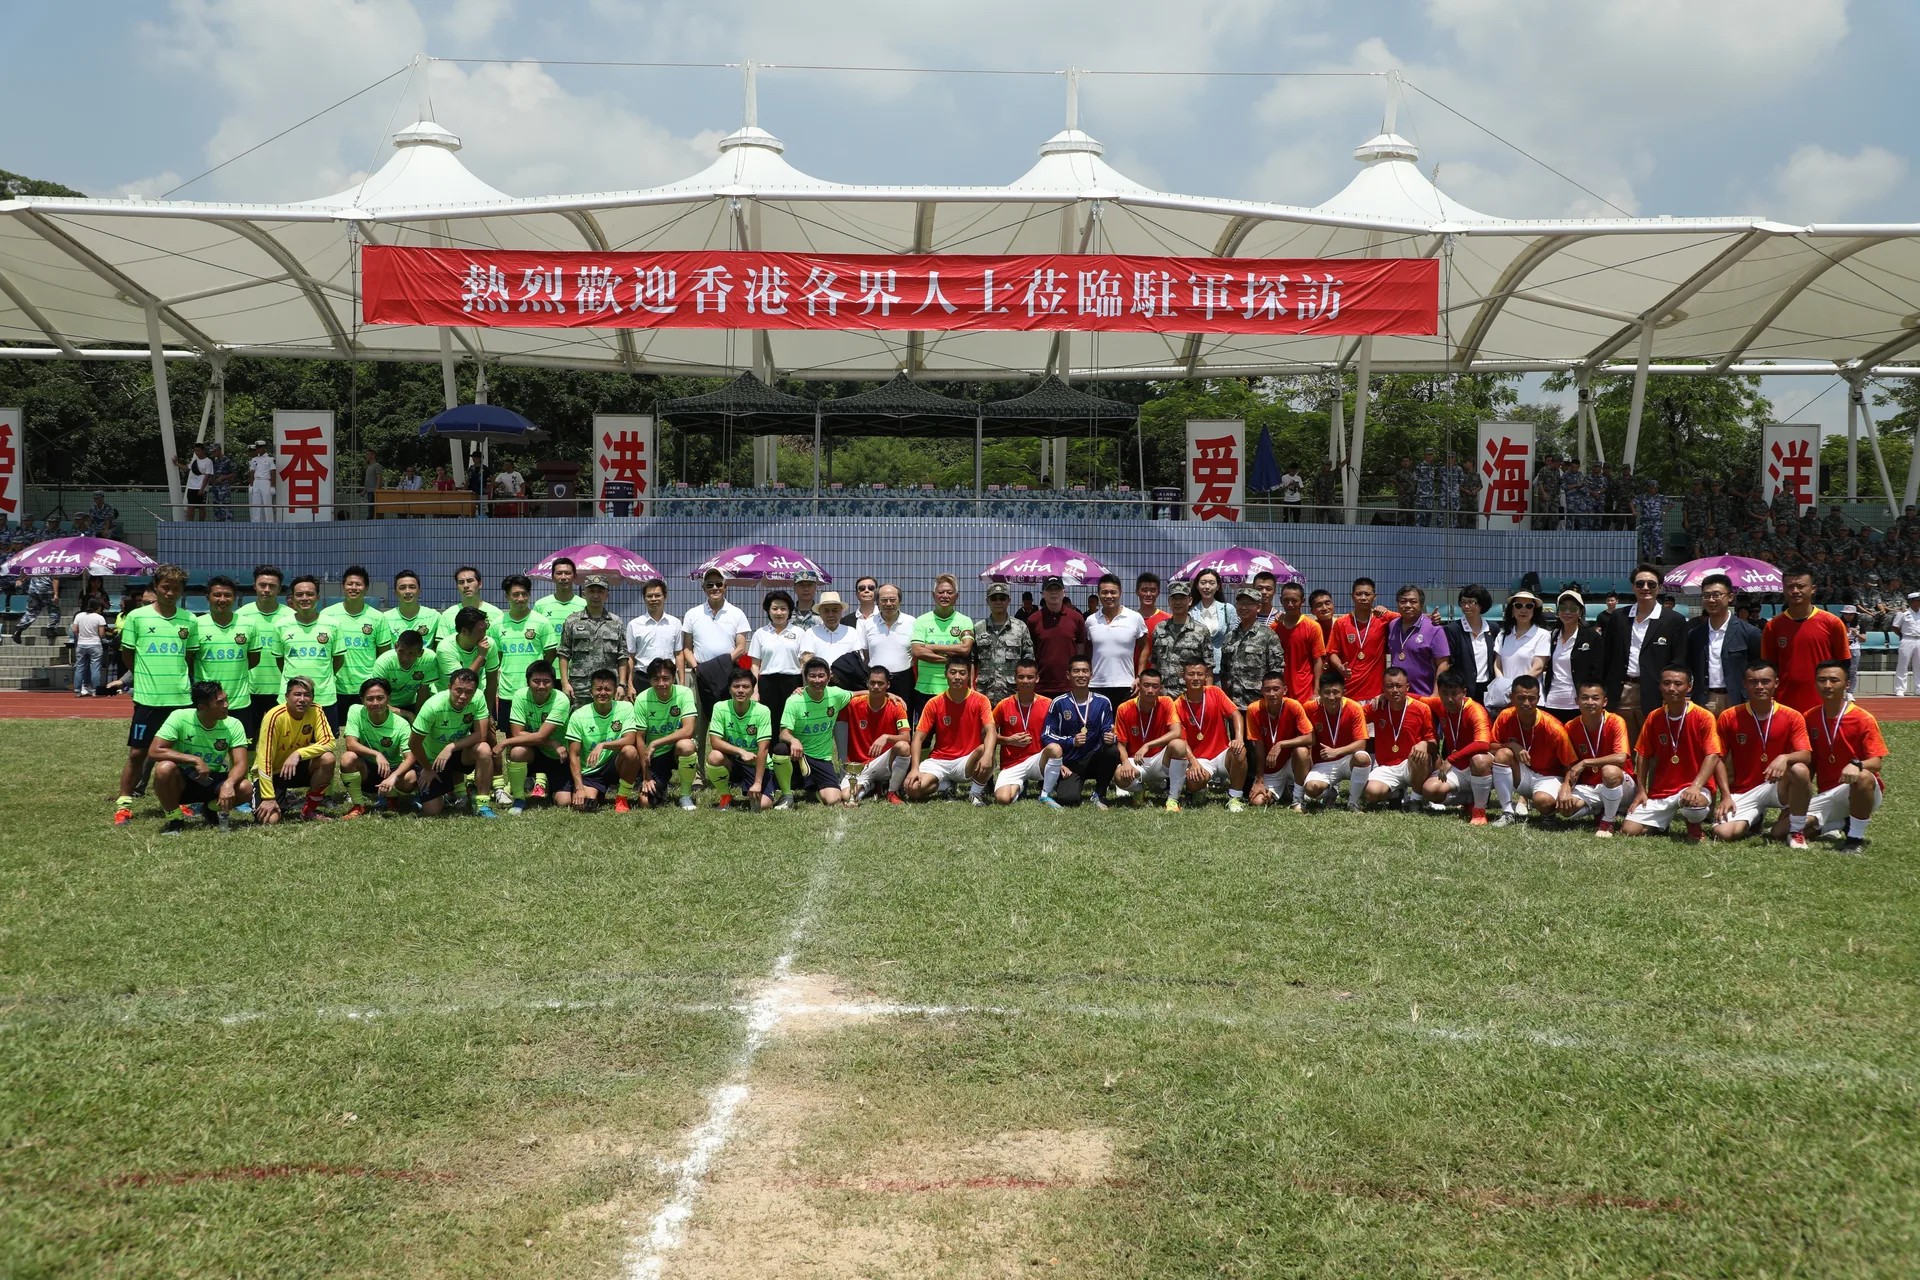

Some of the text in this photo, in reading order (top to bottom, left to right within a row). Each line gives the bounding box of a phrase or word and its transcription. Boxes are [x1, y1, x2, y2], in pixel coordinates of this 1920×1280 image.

[459, 264, 1346, 322] 熱烈歡迎香港各界人士莅臨駐軍探訪
[279, 426, 329, 514] 香
[1482, 436, 1530, 523] 海
[37, 549, 81, 564] vita
[768, 556, 807, 570] vita
[622, 558, 656, 573] vita
[1013, 559, 1052, 573] vita
[1740, 569, 1783, 583] vita
[344, 636, 370, 648] SSA
[204, 648, 245, 660] ASSA
[288, 646, 327, 658] ASSA
[133, 723, 147, 740] 17
